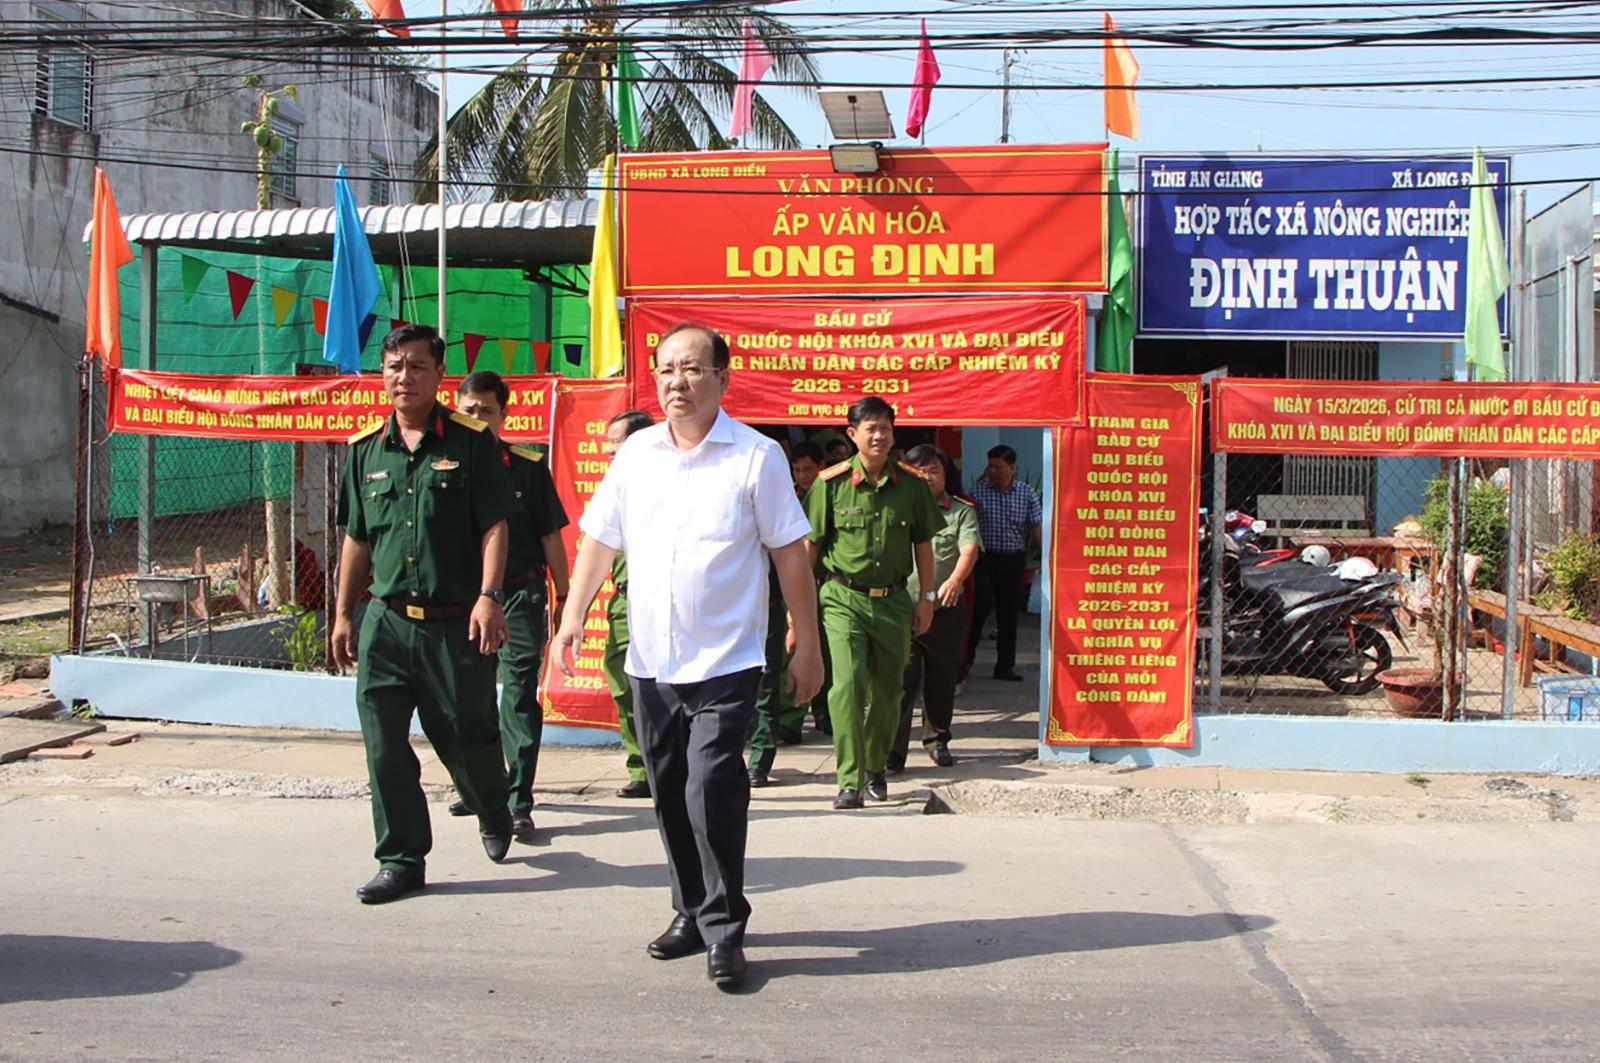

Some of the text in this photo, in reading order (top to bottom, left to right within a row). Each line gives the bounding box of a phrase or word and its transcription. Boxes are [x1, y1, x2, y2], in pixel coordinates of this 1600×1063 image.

[630, 168, 667, 180] UBND
[693, 166, 729, 178] LONG
[1151, 164, 1263, 188] TỈNH AN GIANG
[1416, 172, 1458, 188] LONG
[777, 172, 935, 198] VĂN PHÒNG
[772, 203, 945, 236] ẤP VĂN HÓA
[1174, 203, 1220, 241] HỢP
[1226, 198, 1271, 235] TÁC
[1275, 201, 1308, 236] XÃ
[1313, 199, 1381, 236] NÔNG
[726, 243, 995, 283] LONG ĐỊNH
[1190, 246, 1459, 323] ĐỊNH THUẬN
[862, 309, 893, 327] CỬ
[737, 330, 792, 350] QUỐC
[799, 334, 834, 354] HỘI
[840, 331, 895, 349] KHÓA
[902, 333, 935, 348] XVI
[941, 330, 968, 348] VÀ
[973, 331, 1009, 351] ĐẠI
[1016, 326, 1065, 347] BIỂU
[750, 355, 806, 371] NHÂN
[813, 354, 856, 371] DÂN
[862, 353, 903, 371] CÁC
[910, 350, 952, 371] CẤP
[959, 352, 1028, 374] NHIỆM
[791, 379, 841, 394] 2026
[862, 379, 910, 394] 2031
[125, 383, 157, 401] NHIỆT
[161, 384, 186, 404] LIỆT
[188, 386, 221, 403] CHÀO
[224, 387, 260, 405] MỪNG
[263, 388, 296, 406] NGÀY
[332, 386, 351, 405] CỬ
[353, 390, 375, 409] ĐẠI
[522, 390, 544, 406] XVI
[789, 404, 809, 416] KHU
[1274, 394, 1312, 414] NGÀY
[1317, 398, 1391, 417] 15/3/2026,
[1395, 393, 1417, 416] CỬ
[1419, 399, 1441, 416] TRI
[1446, 394, 1465, 416] CẢ
[1469, 396, 1509, 416] NƯỚC
[1513, 399, 1528, 416] ĐI
[1567, 395, 1589, 417] CỬ
[125, 406, 140, 422] VÀ
[143, 408, 163, 427] ĐẠI
[166, 405, 194, 426] BIỂU
[197, 409, 218, 430] HỘI
[257, 411, 293, 430] NHÂN
[296, 411, 323, 430] DÂN
[327, 411, 354, 431] CÁC
[1088, 416, 1169, 430] THAM GIA
[1228, 420, 1267, 440] KHÓA
[1270, 423, 1294, 440] XVI
[1298, 421, 1316, 441] VÀ
[1320, 424, 1344, 445] ĐẠI
[1349, 419, 1381, 442] BIỂU
[1385, 422, 1410, 446] HỘI
[1458, 423, 1499, 443] NHÂN
[1503, 423, 1534, 443] DÂN
[1538, 424, 1567, 444] CÁC
[1571, 422, 1600, 445] CẤP
[1091, 450, 1164, 467] ĐẠI BIỂU
[1087, 468, 1168, 486] QUỐC HỘI
[1088, 488, 1166, 503] KHÓA XVI
[1076, 506, 1176, 522] VÀ ĐẠI BIỂU
[1085, 526, 1115, 540] HỘI
[1083, 544, 1168, 558] NHÂN DÂN
[1088, 561, 1161, 576] CÁC CẤP
[1084, 580, 1137, 596] NHIỆM
[1078, 600, 1170, 613] 2026-2031
[1067, 617, 1087, 630] LÀ
[1083, 635, 1162, 650] NGHĨA VỤ
[1067, 653, 1177, 667] THIÊNG LIÊNG
[1086, 670, 1120, 684] CỦA
[1076, 689, 1122, 703] CÔNG
